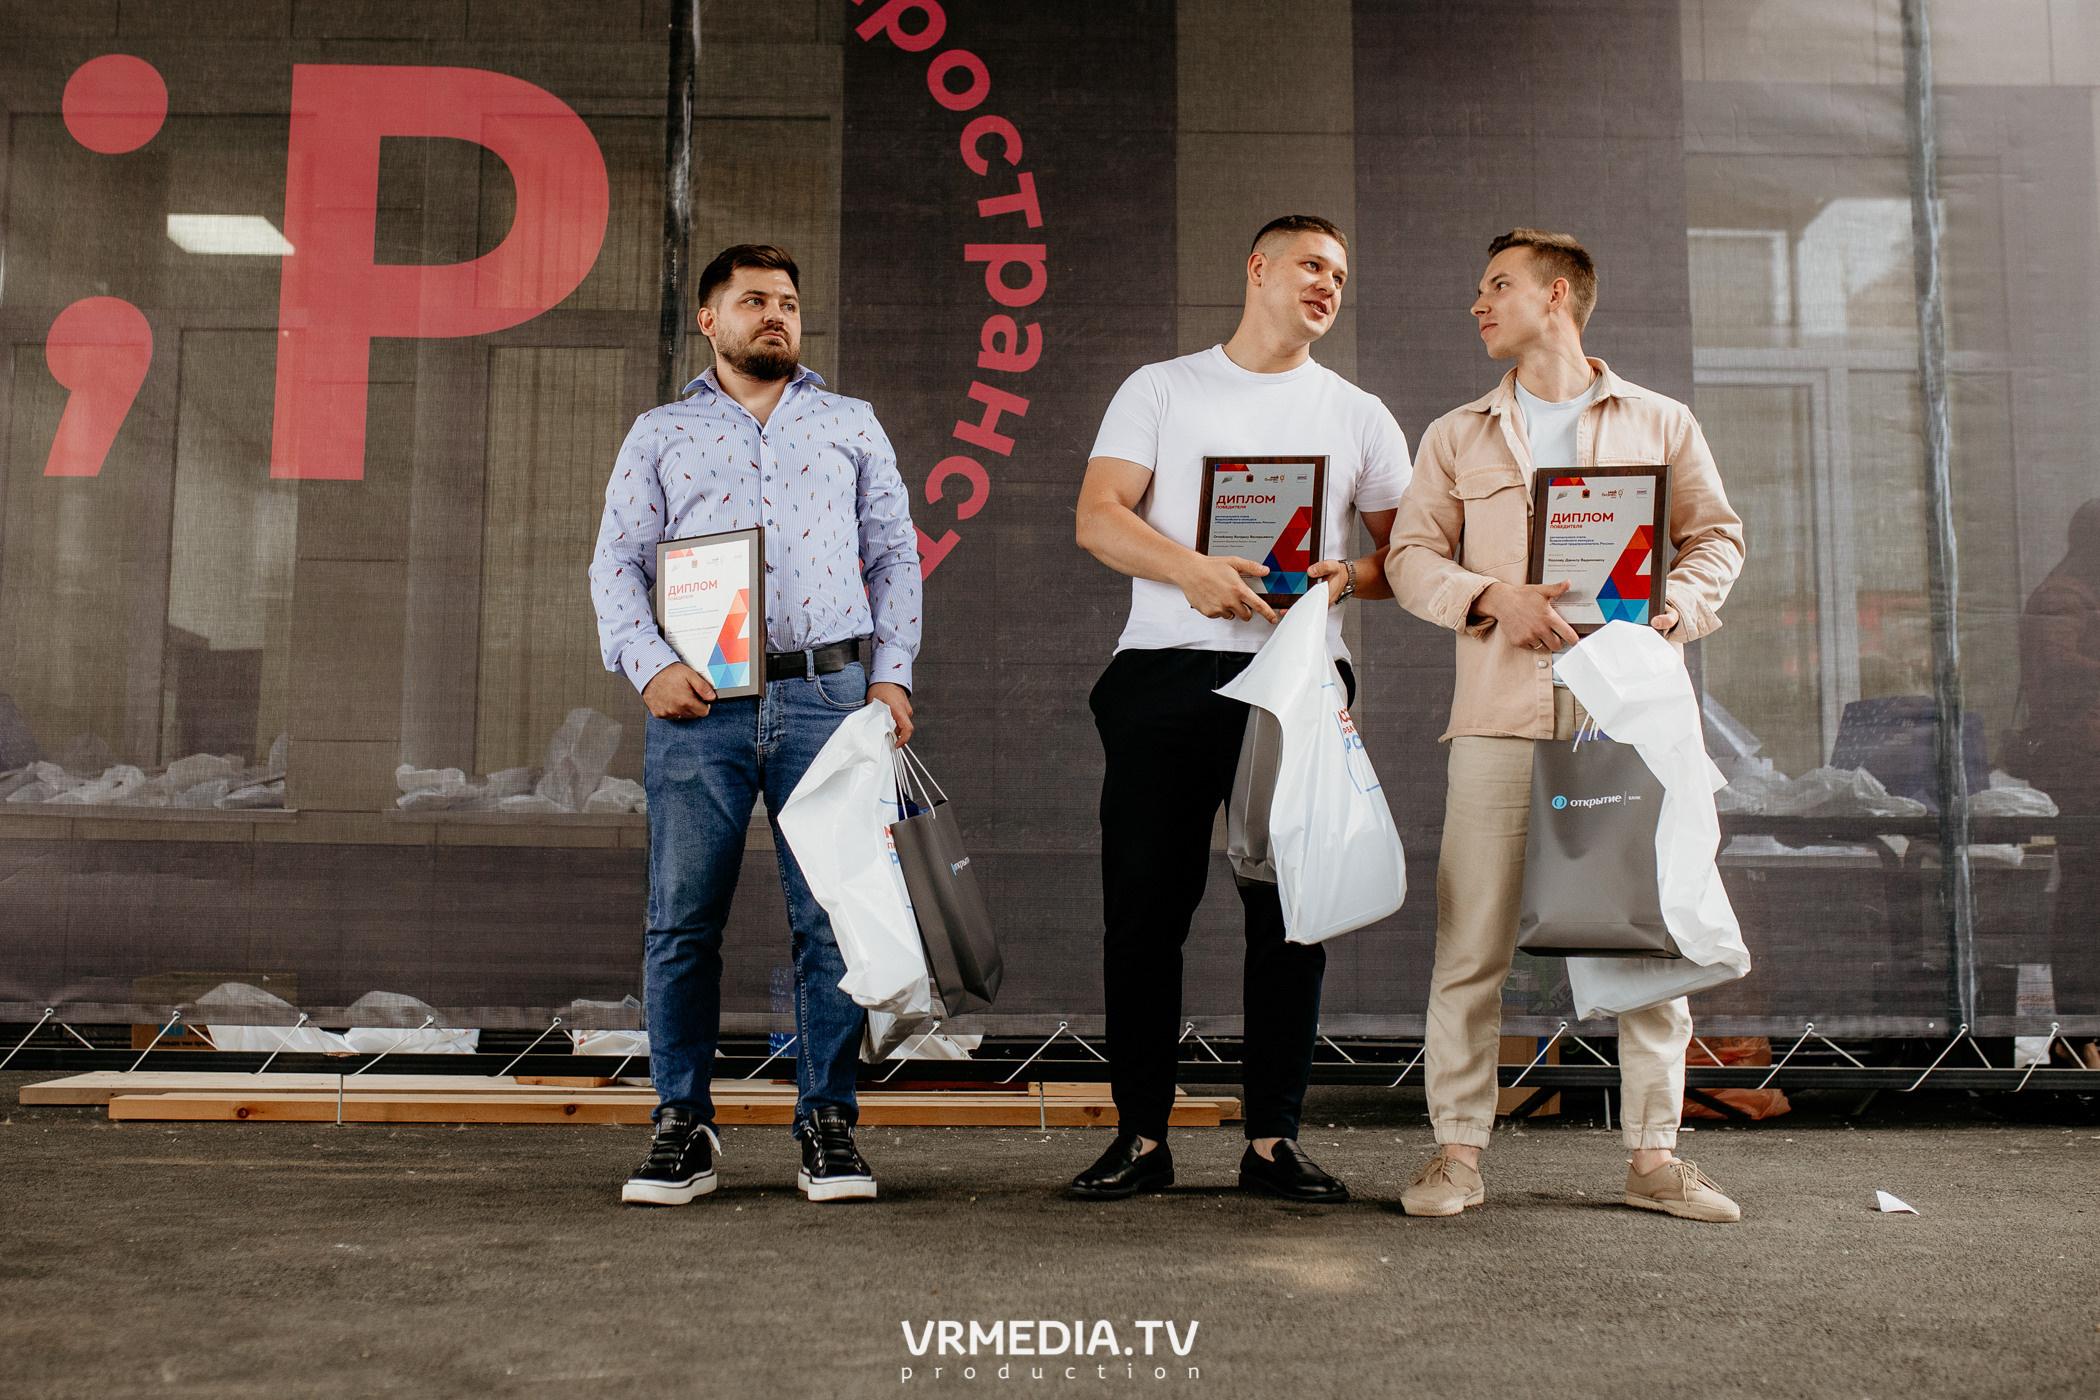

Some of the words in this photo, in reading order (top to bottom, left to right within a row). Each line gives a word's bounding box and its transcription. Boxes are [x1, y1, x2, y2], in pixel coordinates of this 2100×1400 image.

[853, 0, 1048, 600] ространст
[1216, 495, 1276, 505] ДИПЛОМ
[1550, 512, 1614, 524] ДИПЛОМ
[668, 579, 718, 597] ДИПЛОМ
[1570, 794, 1622, 809] открытие
